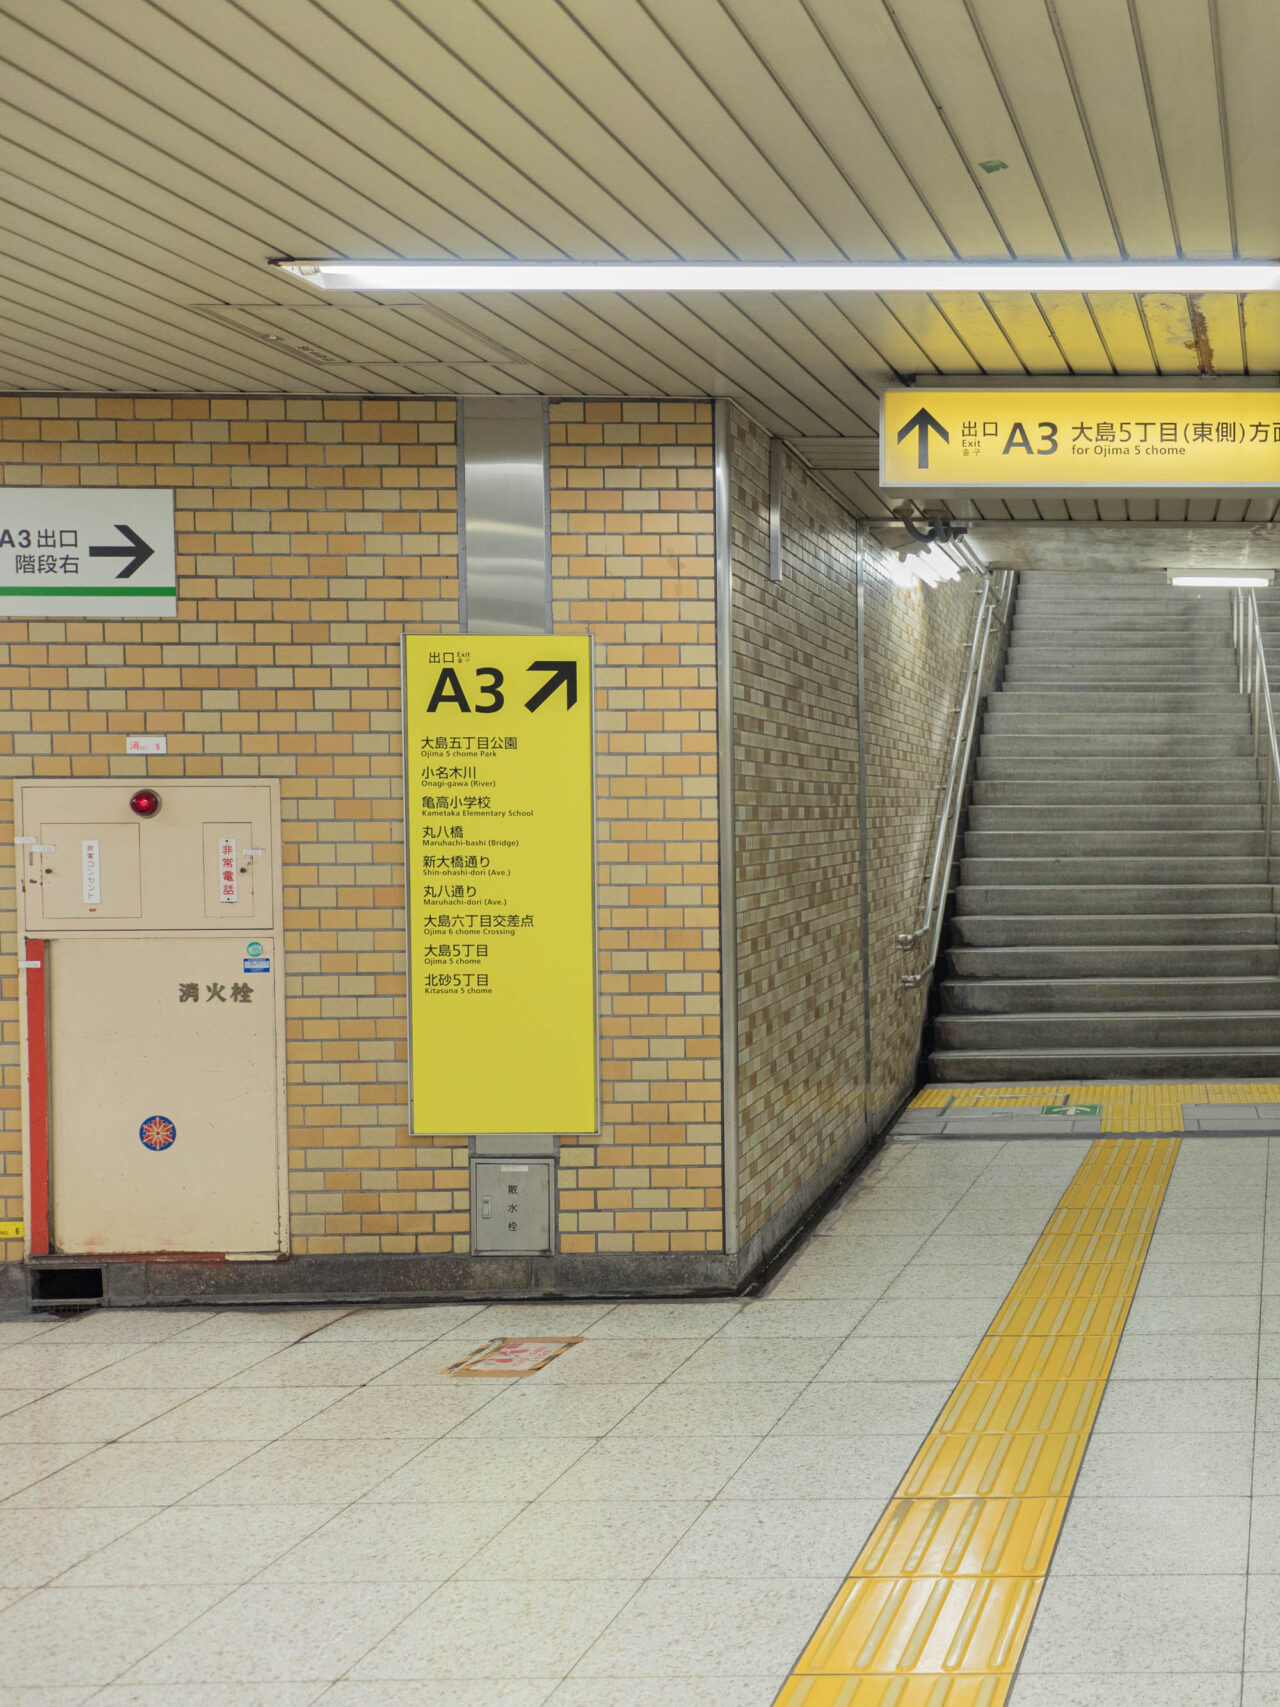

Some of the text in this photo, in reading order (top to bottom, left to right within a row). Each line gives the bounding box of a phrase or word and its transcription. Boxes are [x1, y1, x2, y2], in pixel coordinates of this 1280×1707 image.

[961, 420, 998, 438] 出口
[961, 438, 981, 448] Exit
[1002, 421, 1058, 456] A3
[1072, 444, 1186, 458] for Ojima 5 chome
[0, 529, 78, 549] A3出口
[15, 554, 80, 574] 階段右
[428, 652, 455, 664] 出口
[426, 667, 505, 714] A3
[421, 737, 518, 750] 大島五丁目公園
[421, 766, 476, 780] 小名木川
[421, 780, 469, 788] Onagi-gawa
[422, 796, 491, 809] 亀高小学校
[463, 810, 506, 818] Elementary
[422, 826, 464, 839] 丸八橋
[422, 855, 490, 868] 新大橋通り
[222, 844, 234, 895] 非常電話
[423, 885, 477, 898] 丸八通り
[424, 915, 534, 928] 大島六丁目交差点
[424, 945, 488, 957] 大島5丁目
[425, 974, 489, 987] 北砂5丁目
[178, 982, 254, 1003] 消火栓
[507, 1184, 518, 1232] 散水栓
